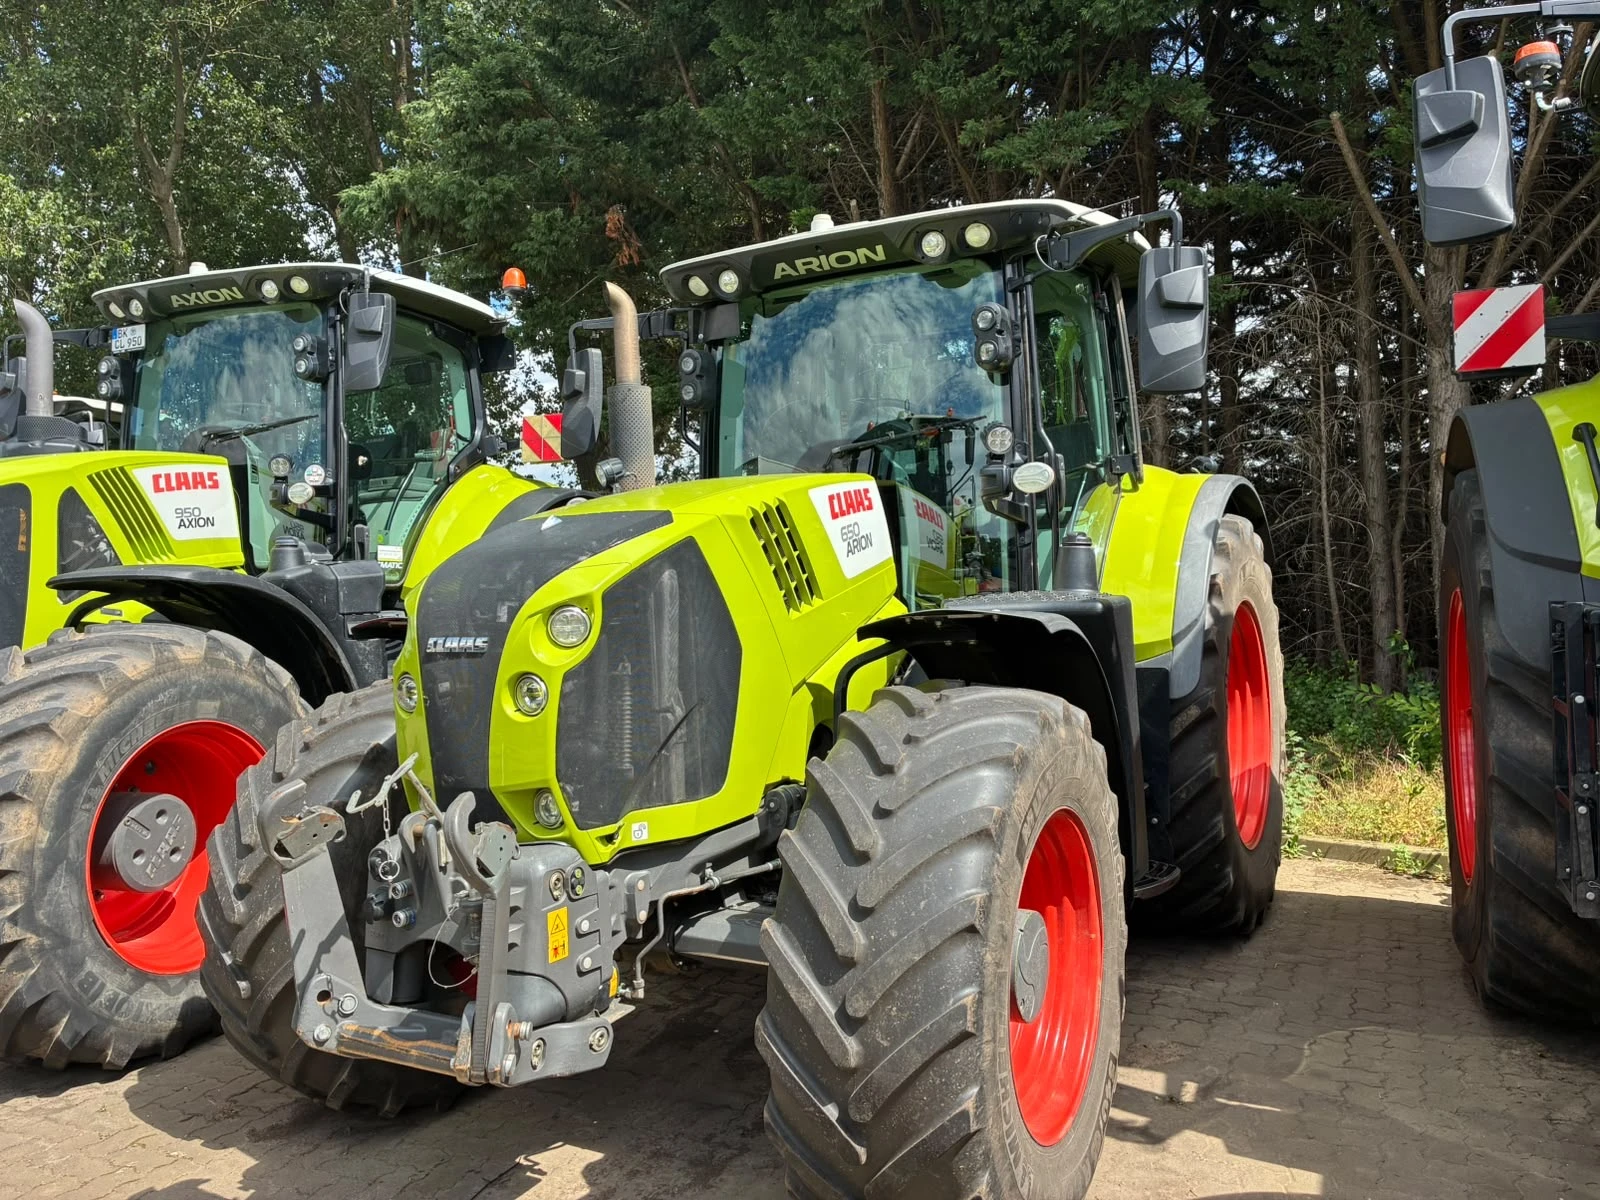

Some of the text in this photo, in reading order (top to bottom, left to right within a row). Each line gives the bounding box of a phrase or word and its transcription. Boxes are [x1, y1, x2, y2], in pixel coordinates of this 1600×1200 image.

[774, 244, 886, 280] ARION
[170, 286, 244, 308] AXION
[115, 336, 142, 350] CL 950
[117, 328, 128, 338] BK
[152, 472, 219, 493] CLAAS
[175, 507, 201, 518] 950
[828, 488, 873, 520] CLAAS
[178, 516, 215, 529] AXION
[840, 522, 860, 542] 650
[846, 532, 873, 558] ARION
[426, 637, 488, 652] CLAAS
